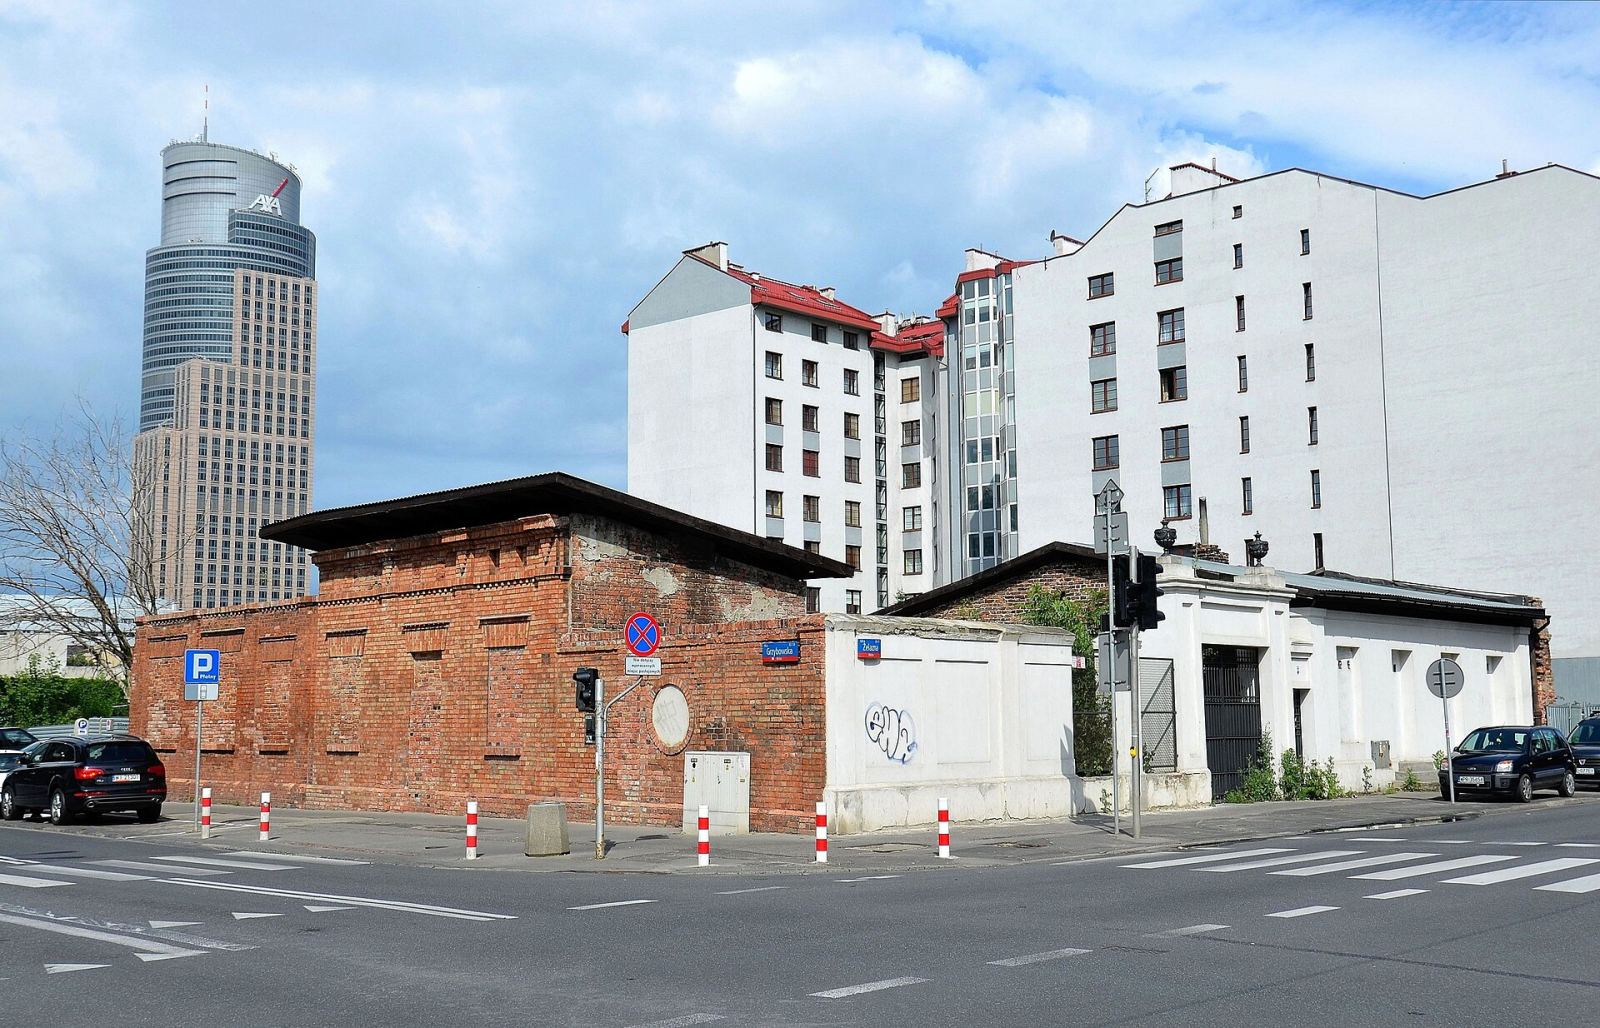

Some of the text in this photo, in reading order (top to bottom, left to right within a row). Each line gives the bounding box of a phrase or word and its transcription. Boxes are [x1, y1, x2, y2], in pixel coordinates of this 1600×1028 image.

[248, 193, 283, 217] AXA
[766, 646, 794, 657] Grzybowska
[193, 654, 213, 679] P
